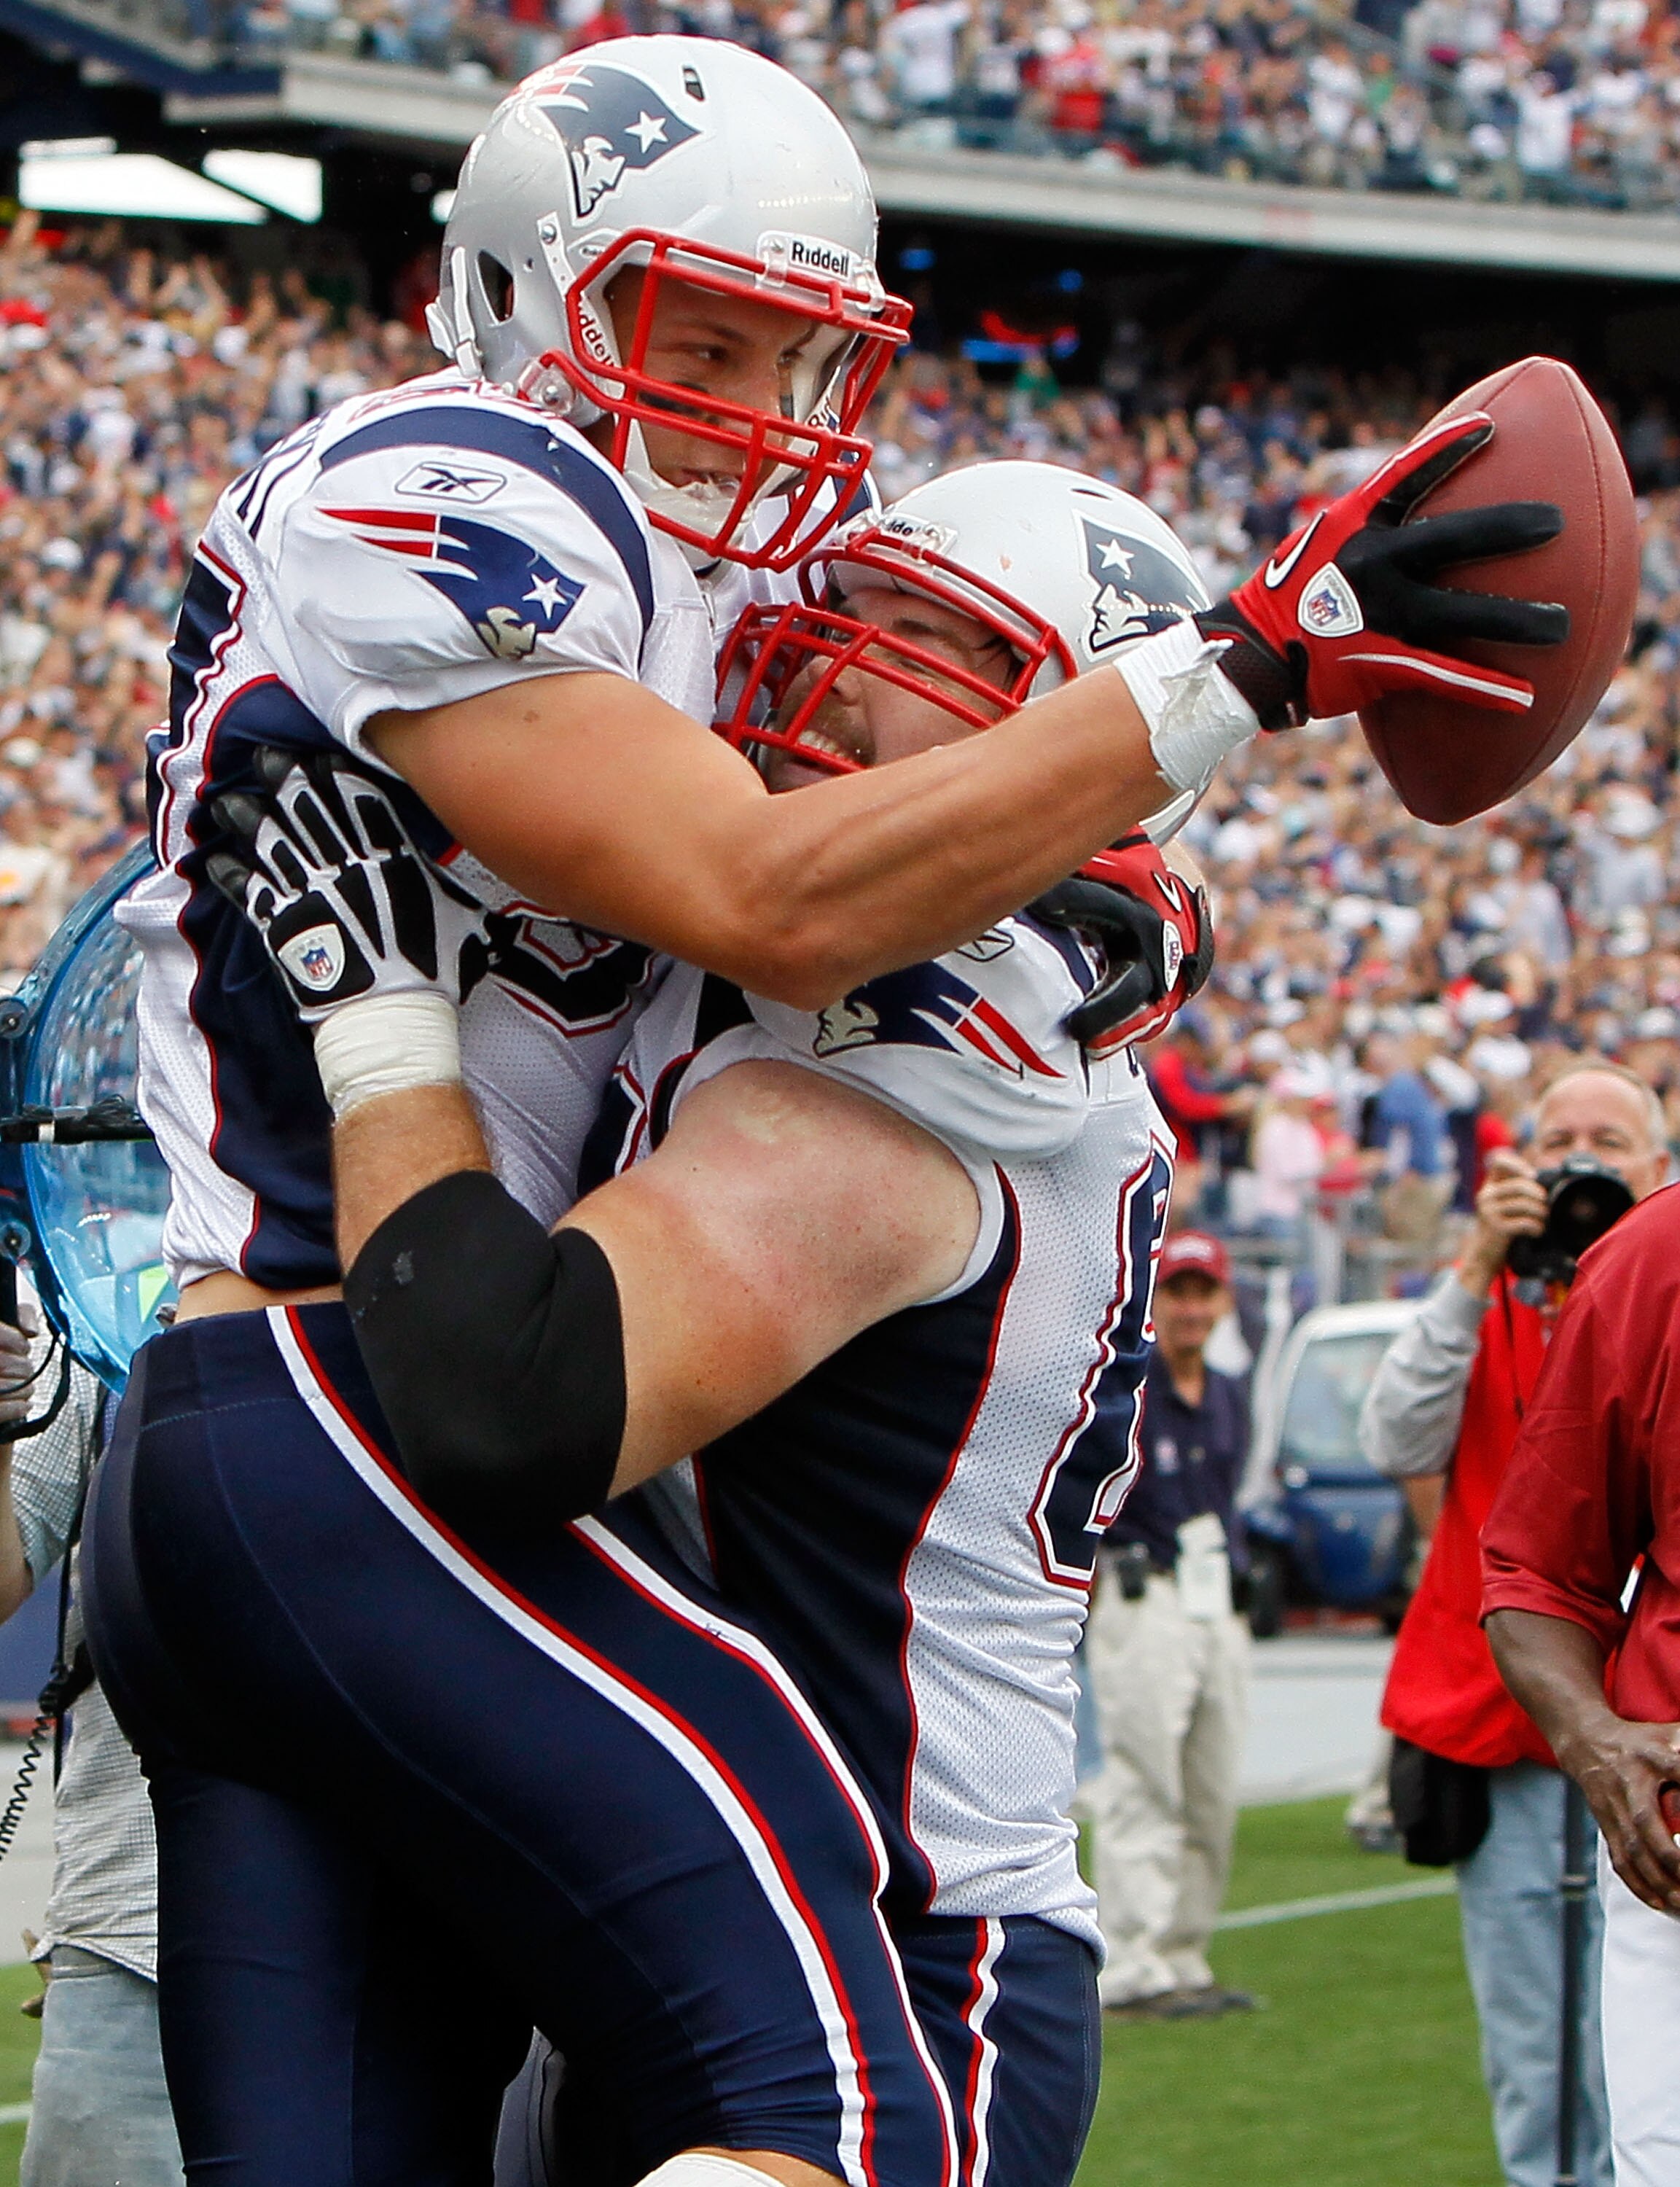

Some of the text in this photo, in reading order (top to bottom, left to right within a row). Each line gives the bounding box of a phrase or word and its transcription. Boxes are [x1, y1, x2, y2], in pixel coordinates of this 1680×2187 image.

[792, 240, 850, 277] Riddell
[1310, 597, 1333, 625] NFL
[306, 956, 335, 978] NFL
